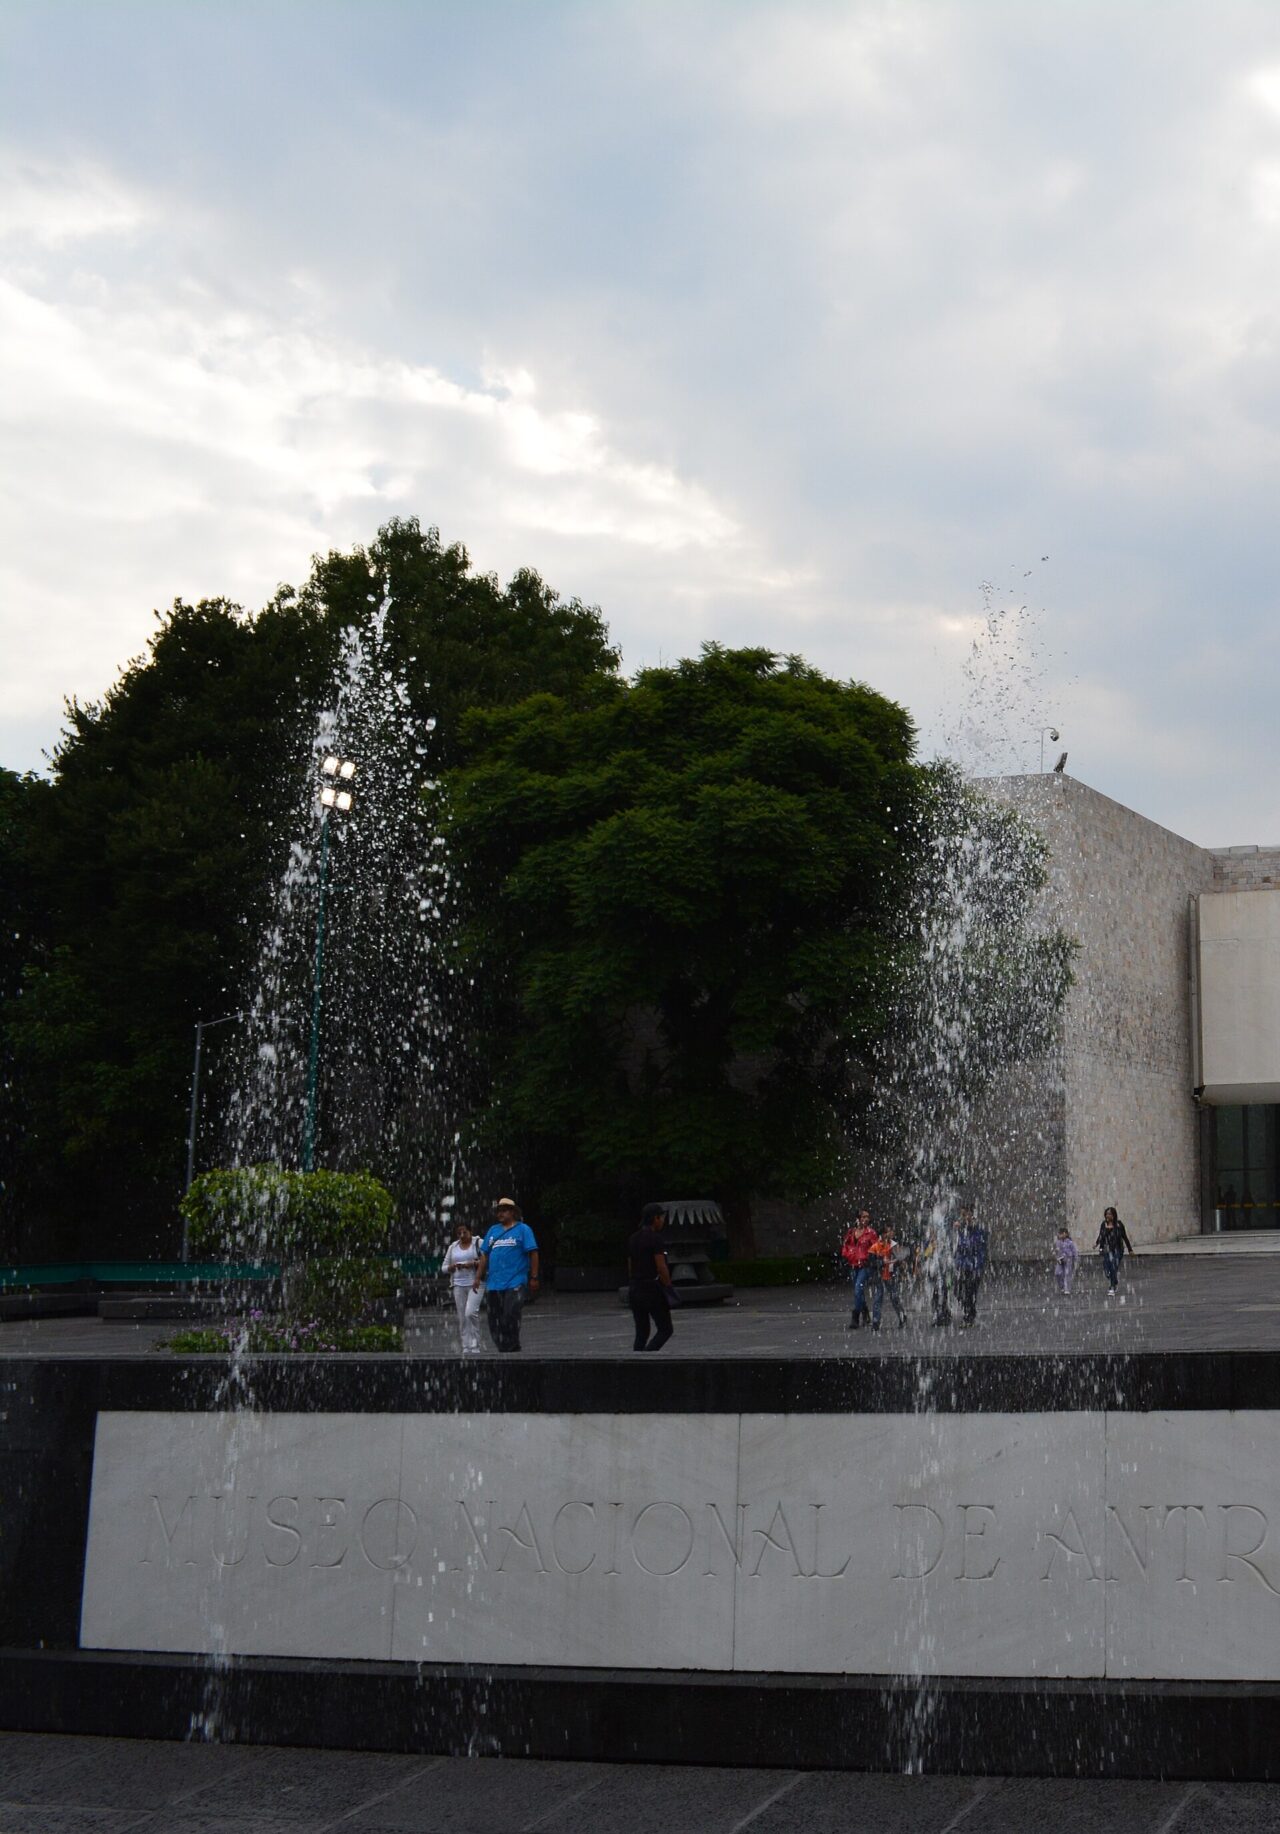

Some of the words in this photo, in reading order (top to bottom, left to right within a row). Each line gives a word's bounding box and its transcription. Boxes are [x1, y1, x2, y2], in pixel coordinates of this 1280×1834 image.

[138, 1495, 418, 1570] MUSEO
[447, 1499, 852, 1578] NACIONAL
[891, 1504, 1002, 1581] DE
